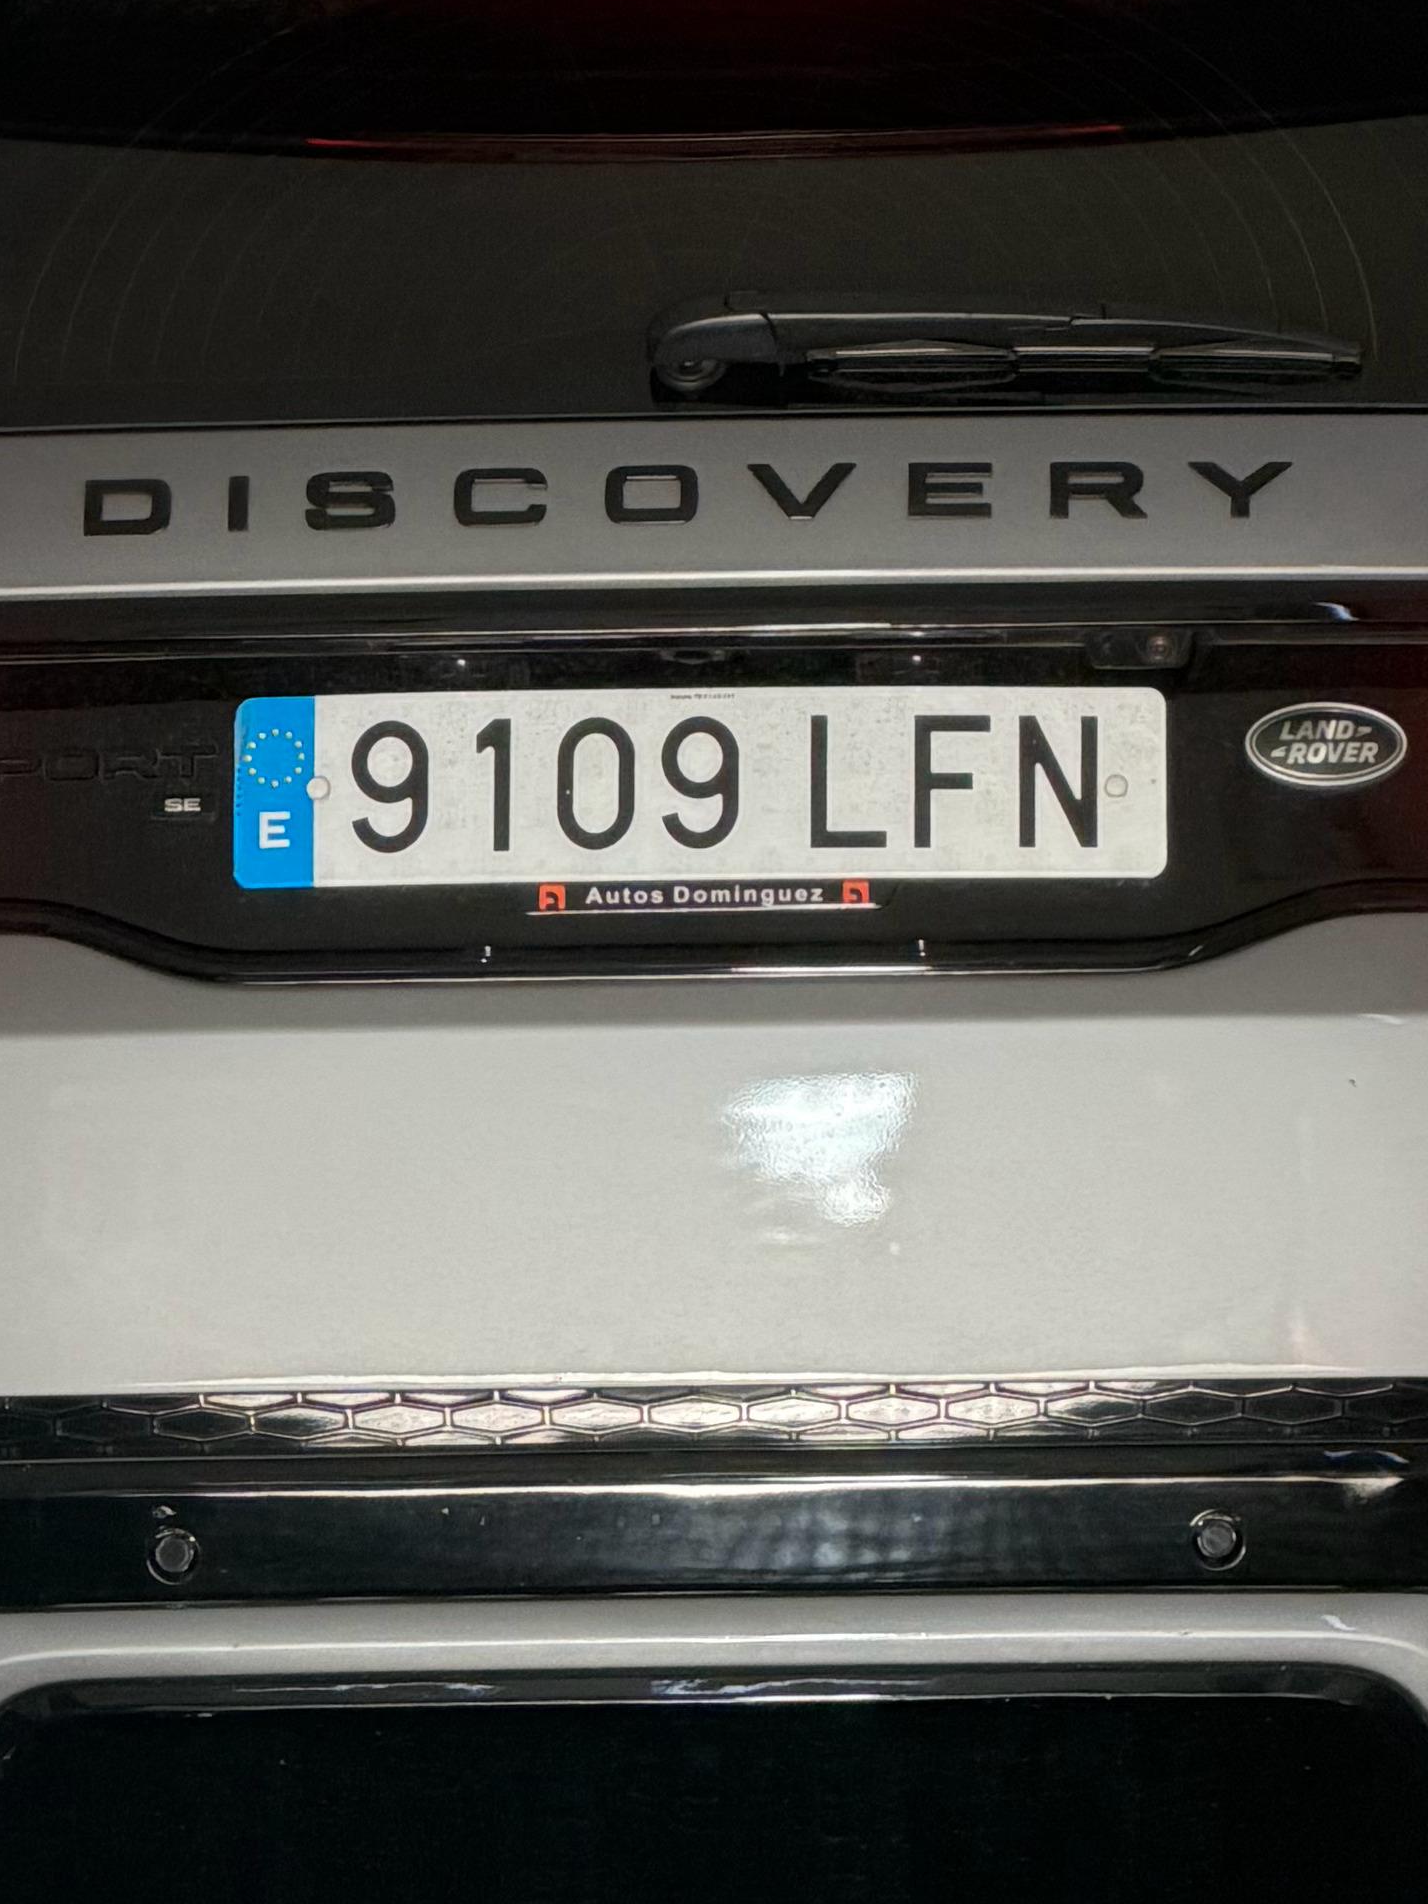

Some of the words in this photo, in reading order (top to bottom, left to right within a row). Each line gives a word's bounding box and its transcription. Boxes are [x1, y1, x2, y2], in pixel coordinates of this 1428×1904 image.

[83, 460, 1295, 536] DISCOVERY
[1279, 719, 1356, 741] LAND
[1286, 741, 1380, 765] ROVER
[350, 715, 740, 853] 9109
[809, 713, 1099, 849] LFN
[164, 797, 202, 812] SE
[258, 810, 291, 849] E
[585, 886, 664, 905] Autos
